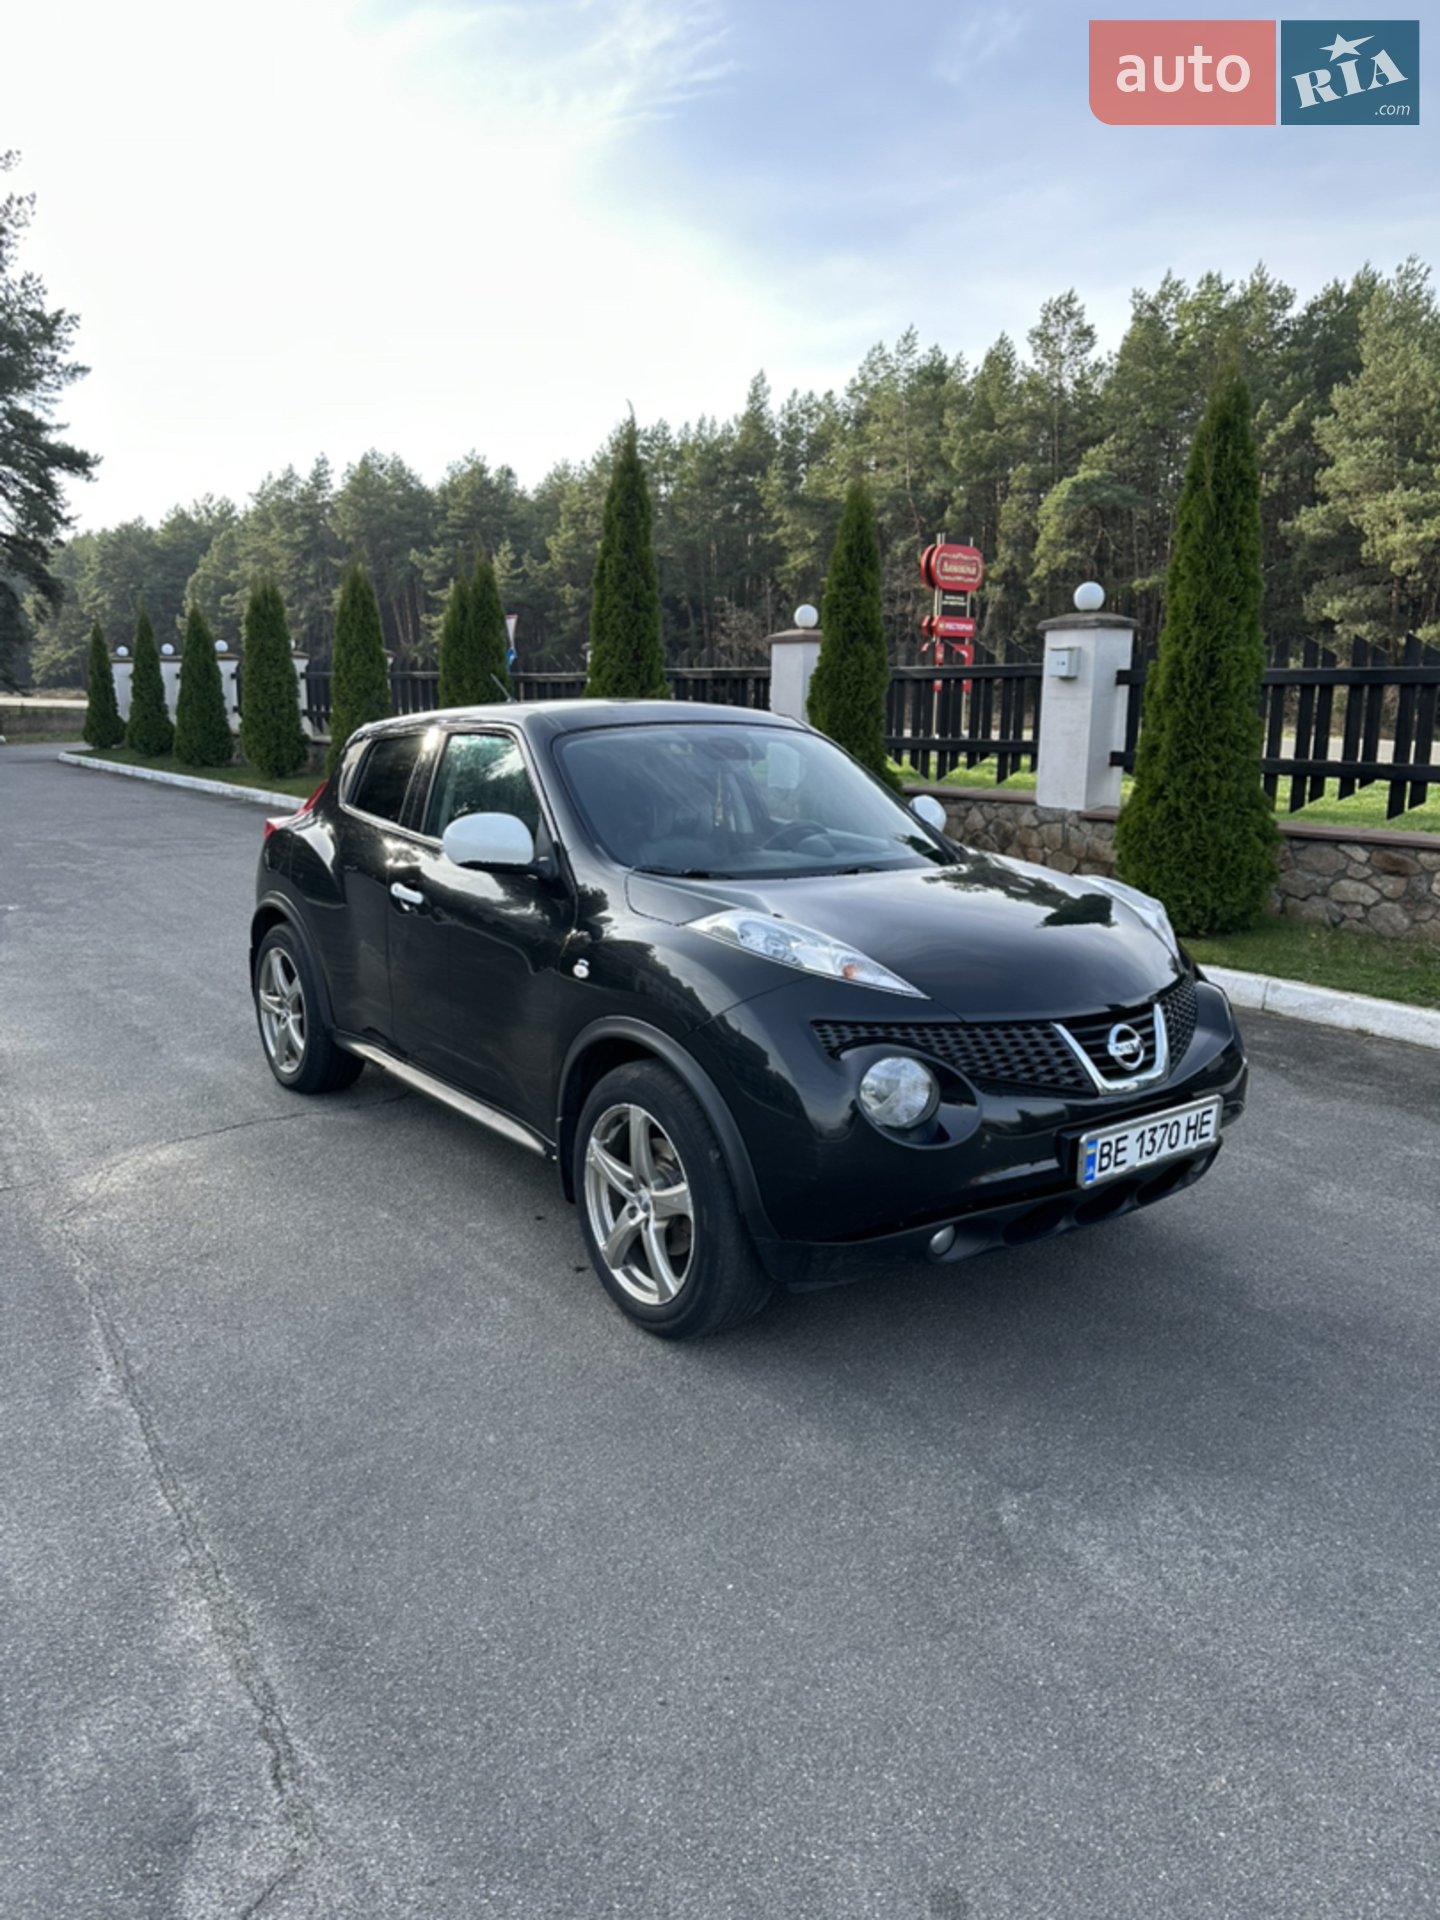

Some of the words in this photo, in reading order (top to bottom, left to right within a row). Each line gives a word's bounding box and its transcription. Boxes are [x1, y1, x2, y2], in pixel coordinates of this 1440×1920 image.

[1097, 1135, 1129, 1173] BE
[1136, 1120, 1181, 1159] 1370
[1183, 1108, 1213, 1145] HE
